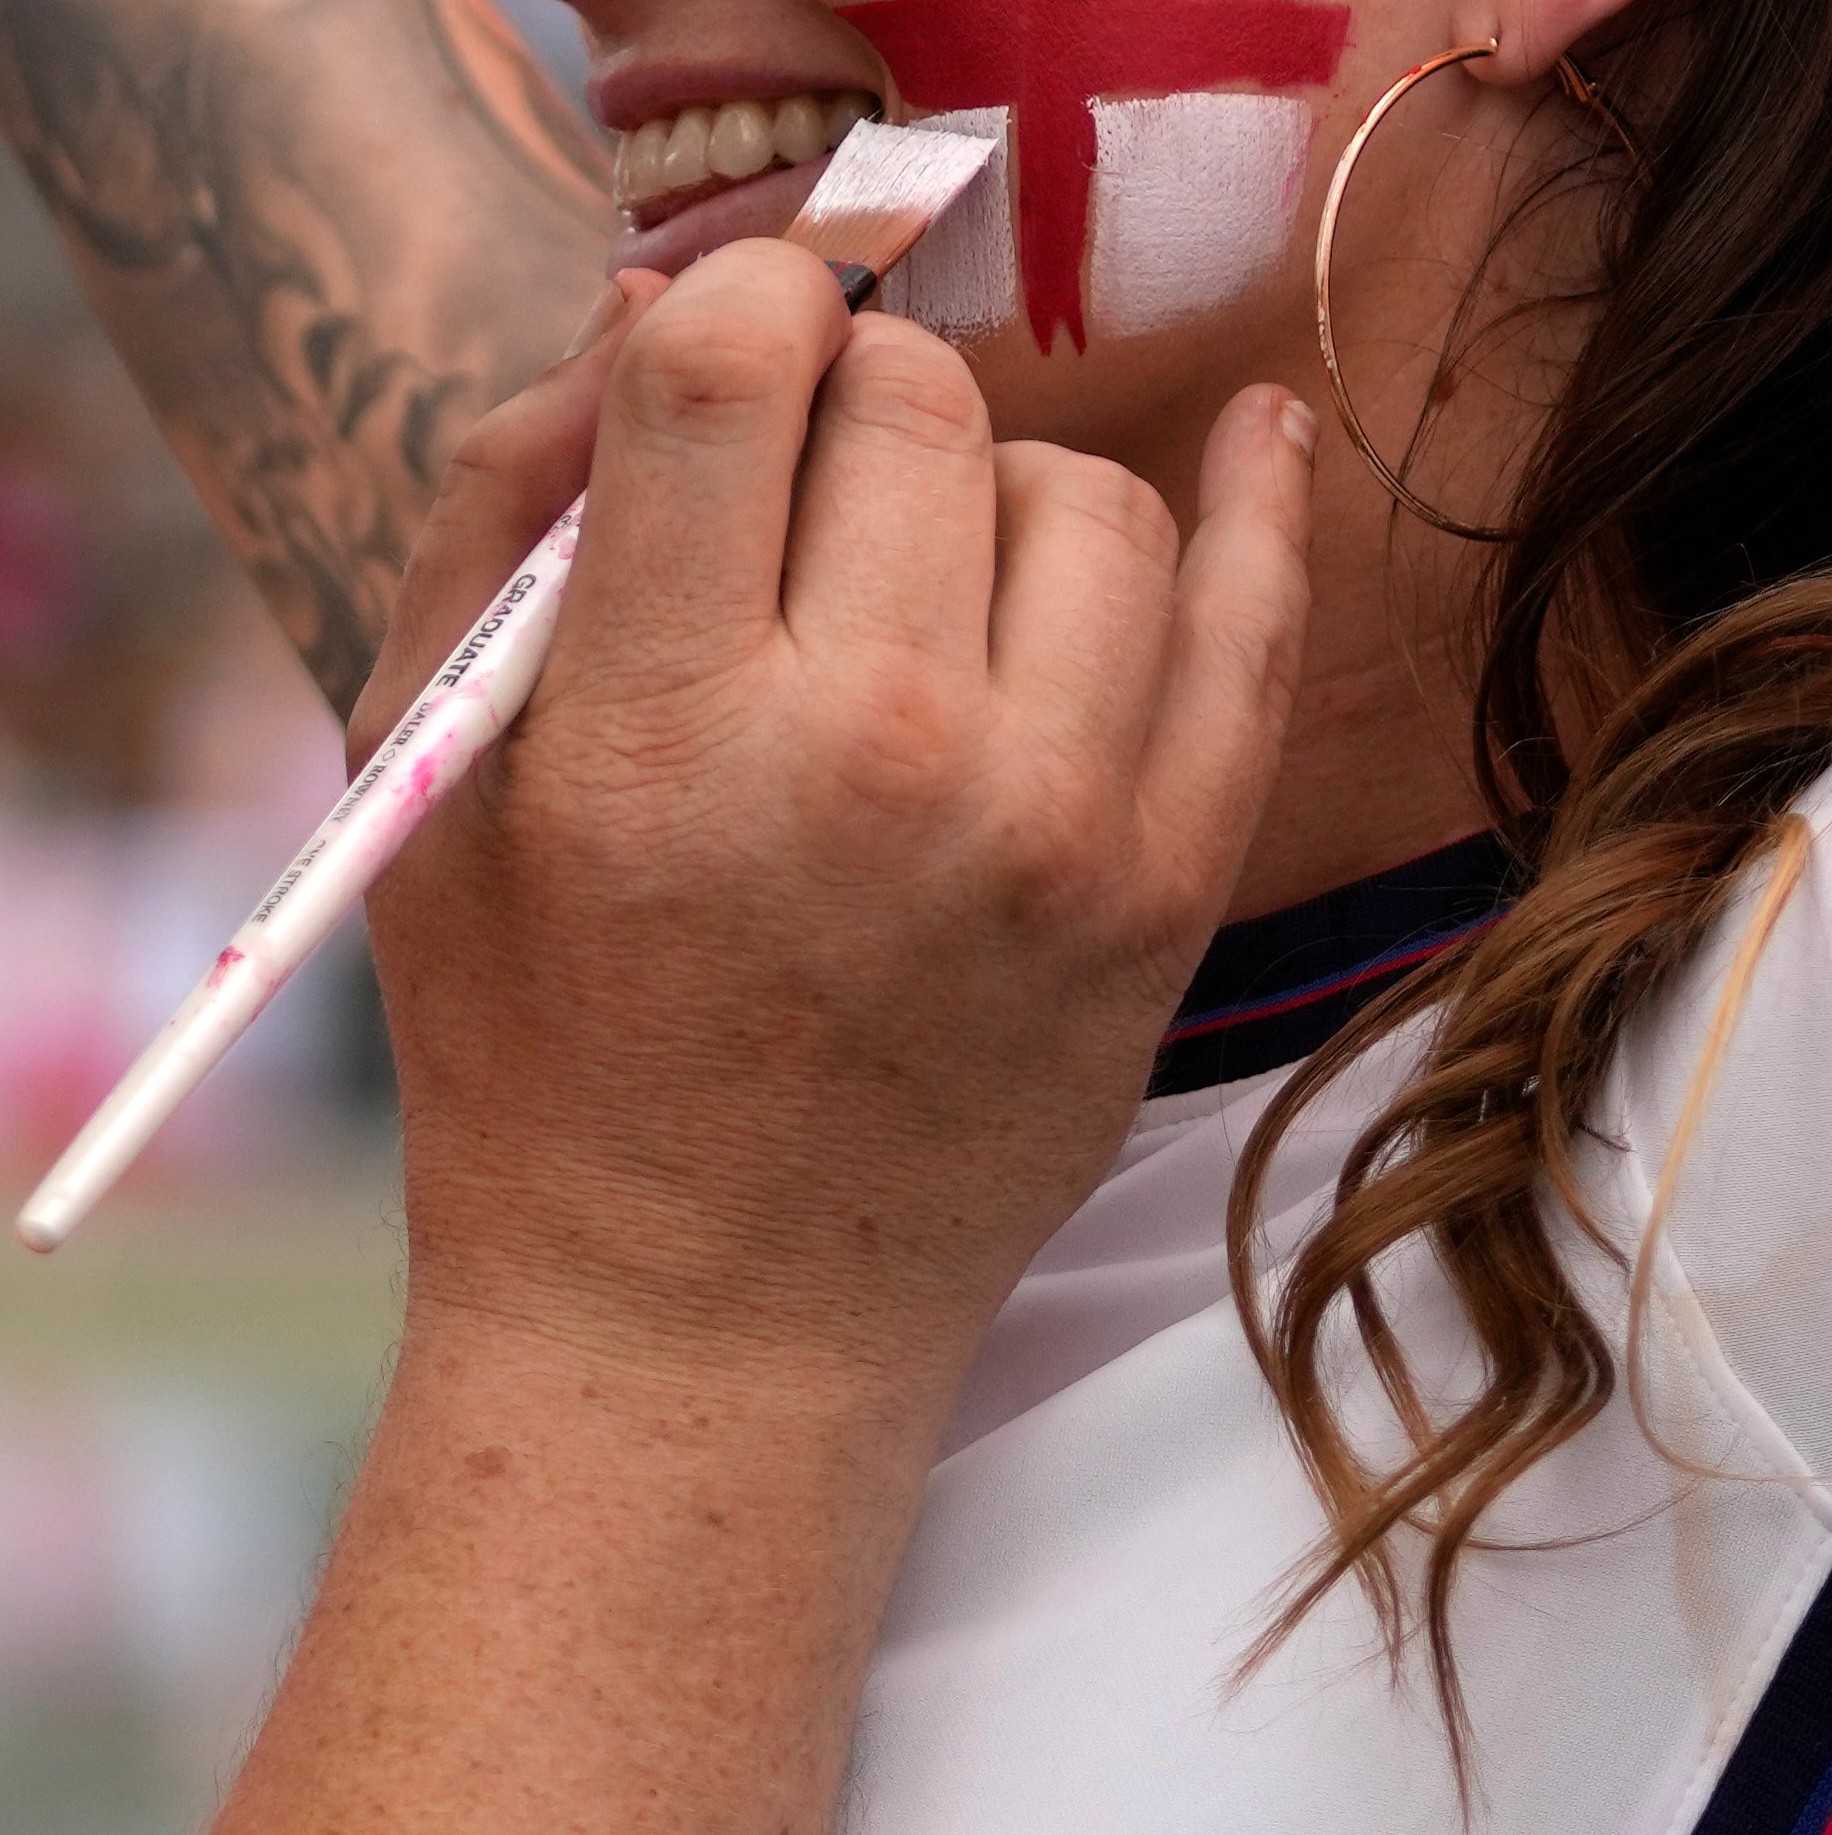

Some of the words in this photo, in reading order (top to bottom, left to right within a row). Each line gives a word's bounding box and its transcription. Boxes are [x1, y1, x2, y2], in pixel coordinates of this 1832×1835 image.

[435, 573, 537, 688] GRADUATE
[391, 702, 434, 746] DALER
[251, 869, 302, 923] STROKE
